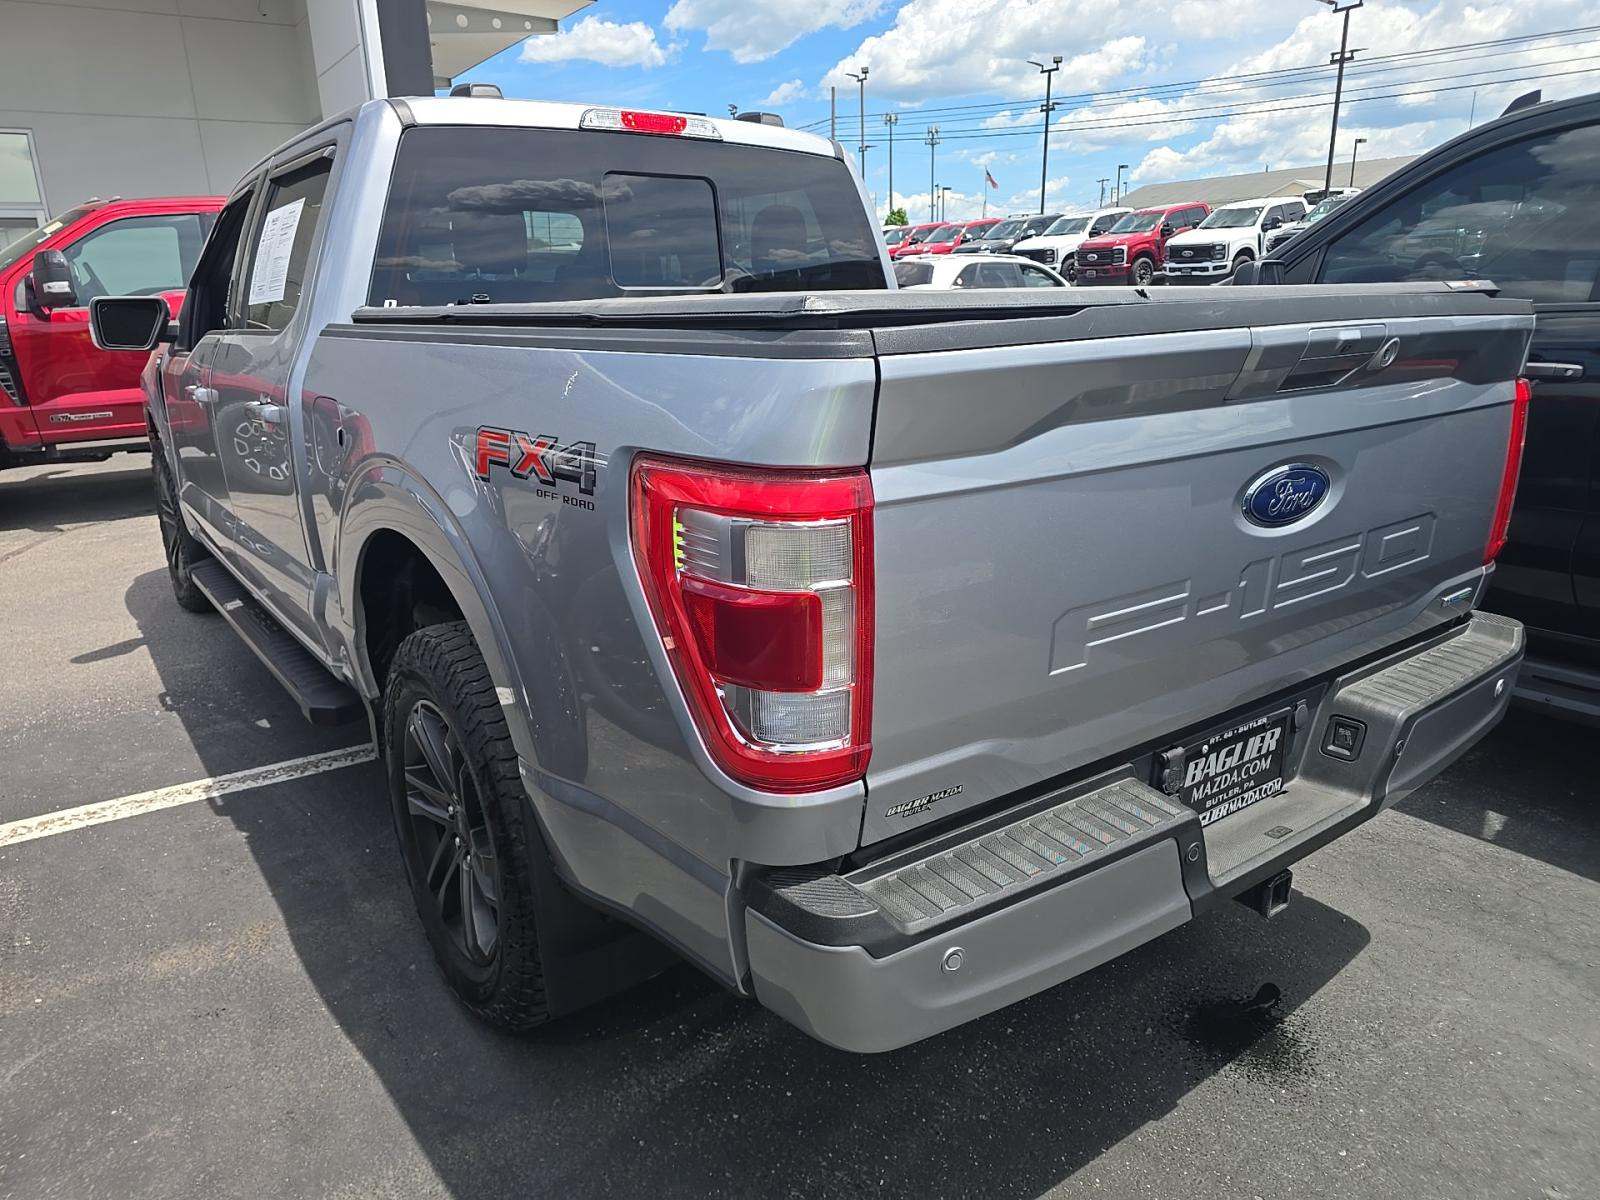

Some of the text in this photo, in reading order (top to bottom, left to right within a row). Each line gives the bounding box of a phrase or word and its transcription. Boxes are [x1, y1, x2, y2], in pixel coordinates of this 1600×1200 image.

[475, 424, 597, 496] FX4
[536, 488, 595, 512] OFF ROAD
[1266, 478, 1319, 517] Ford
[1049, 511, 1438, 676] F-150
[1209, 734, 1222, 745] RT.
[1237, 717, 1268, 733] BUTLER
[1184, 727, 1281, 788] BAGLIER
[931, 785, 964, 803] MAZDA
[1191, 754, 1272, 803] MAZDA.COM
[1205, 780, 1255, 808] BUTLER, PA
